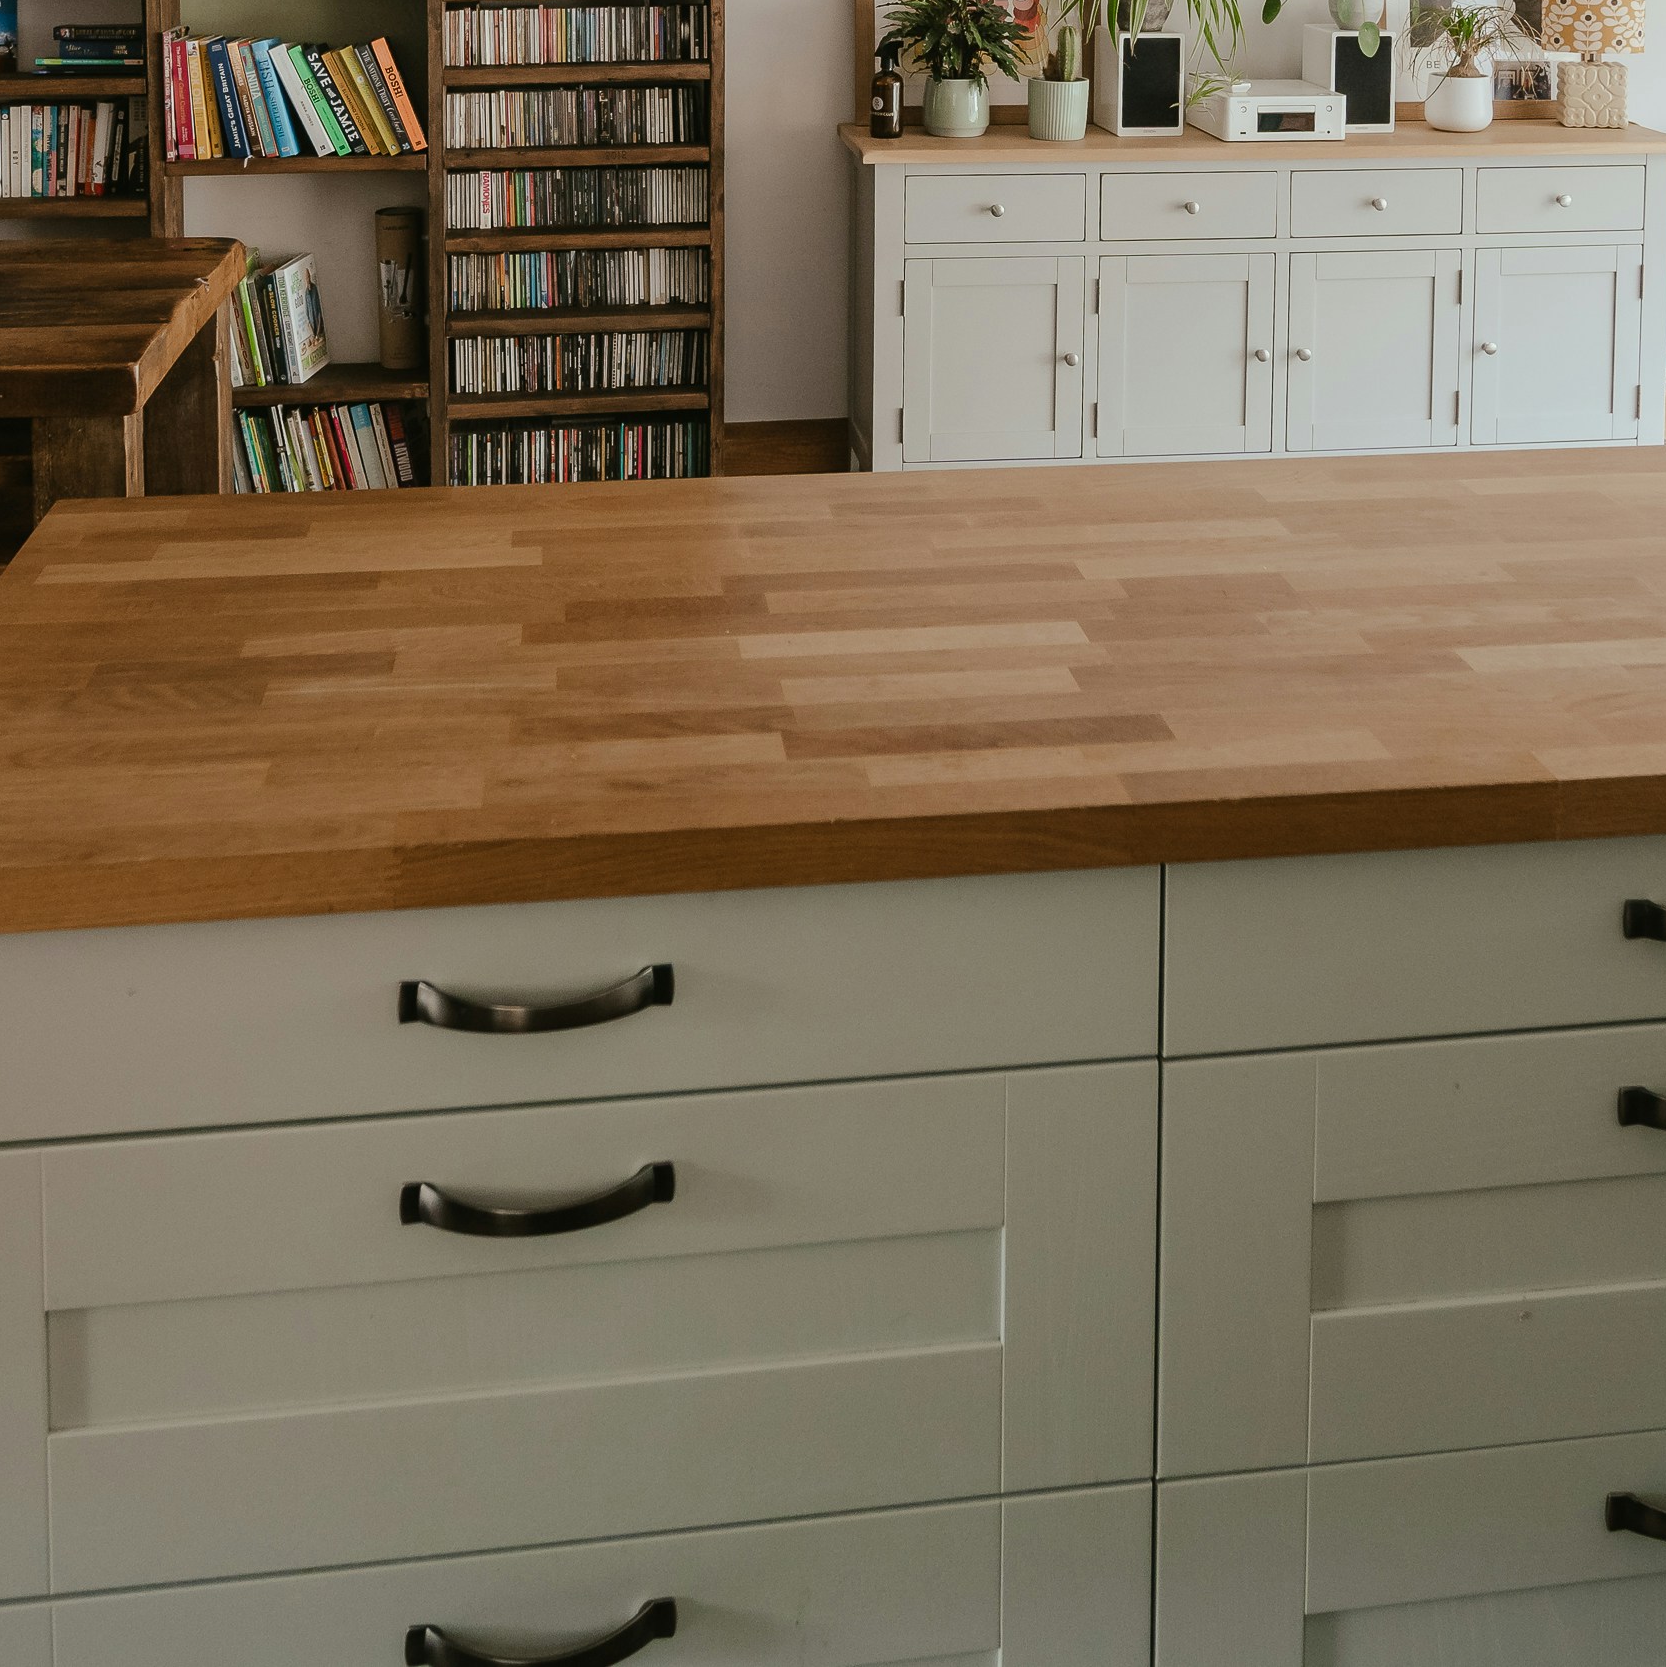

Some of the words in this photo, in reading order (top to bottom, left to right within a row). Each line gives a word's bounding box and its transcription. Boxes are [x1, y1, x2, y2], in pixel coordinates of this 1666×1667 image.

[361, 50, 370, 63] THE
[1426, 60, 1440, 69] BE
[217, 63, 228, 93] BRITAIN
[246, 70, 261, 101] INDIA
[365, 62, 382, 89] NATIONAL
[384, 65, 403, 98] BOSH!
[259, 59, 274, 88] FISH
[270, 98, 285, 138] SHELLFISH
[303, 77, 320, 103] BOSH!
[307, 52, 331, 88] SAVE
[330, 98, 359, 142] JAMIE
[376, 87, 390, 107] TRUST
[226, 94, 235, 119] GREAT
[242, 94, 250, 113] NADIYA
[247, 114, 256, 137] HUSSAIN
[306, 113, 314, 126] JONES
[342, 88, 357, 113] SLIMMING
[354, 113, 366, 131] FOODIE
[232, 120, 241, 148] JAMIE'S
[278, 276, 286, 289] TOM
[279, 289, 290, 318] KERRIDGE
[271, 310, 280, 336] COOKER
